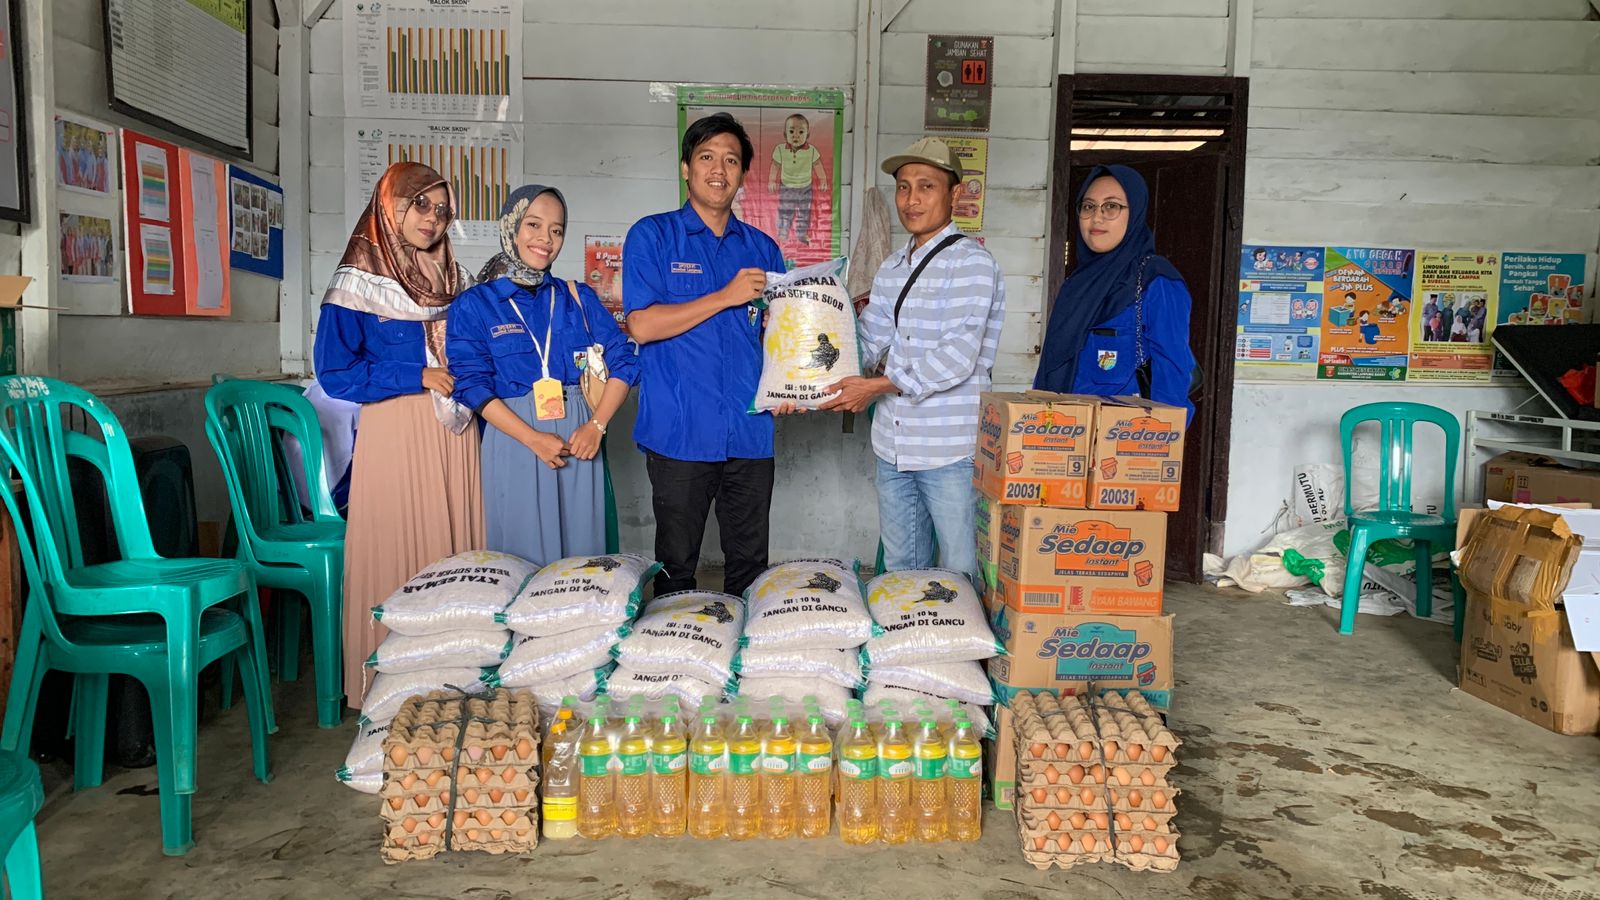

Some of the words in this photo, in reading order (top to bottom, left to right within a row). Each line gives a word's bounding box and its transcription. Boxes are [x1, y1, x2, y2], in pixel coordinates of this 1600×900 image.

[954, 41, 979, 49] GUNAKAN
[945, 48, 967, 56] JAMBAN
[970, 49, 987, 57] SEHAT
[1538, 256, 1562, 264] Hidup
[787, 289, 819, 301] SUPER
[766, 391, 797, 400] JANGAN
[1010, 421, 1086, 438] Sedaap
[1104, 427, 1181, 444] Sedaap
[1072, 461, 1081, 472] 9
[1166, 467, 1175, 477] 9
[1006, 483, 1041, 498] 20031
[1060, 482, 1083, 498] 40
[1100, 488, 1136, 505] 20031
[1155, 486, 1177, 504] 40
[1053, 524, 1077, 534] Mie
[1038, 535, 1144, 560] Sedaap
[437, 567, 472, 577] SUPER
[474, 567, 510, 577] BERAS
[402, 576, 458, 593] SEMAR
[459, 575, 500, 585] KYAI
[529, 586, 566, 598] JANGAN
[762, 606, 800, 618] JANGAN
[815, 605, 847, 613] GANCU
[927, 610, 938, 618] kg
[693, 624, 703, 633] kg
[883, 620, 916, 633] ANGAN
[918, 619, 930, 627] DI
[931, 618, 965, 626] GANCU
[1054, 628, 1079, 637] Mie
[640, 628, 677, 637] JANGAN
[691, 633, 723, 649] GANCU
[1038, 638, 1150, 663] Sedaap
[632, 673, 669, 682] JANGAN
